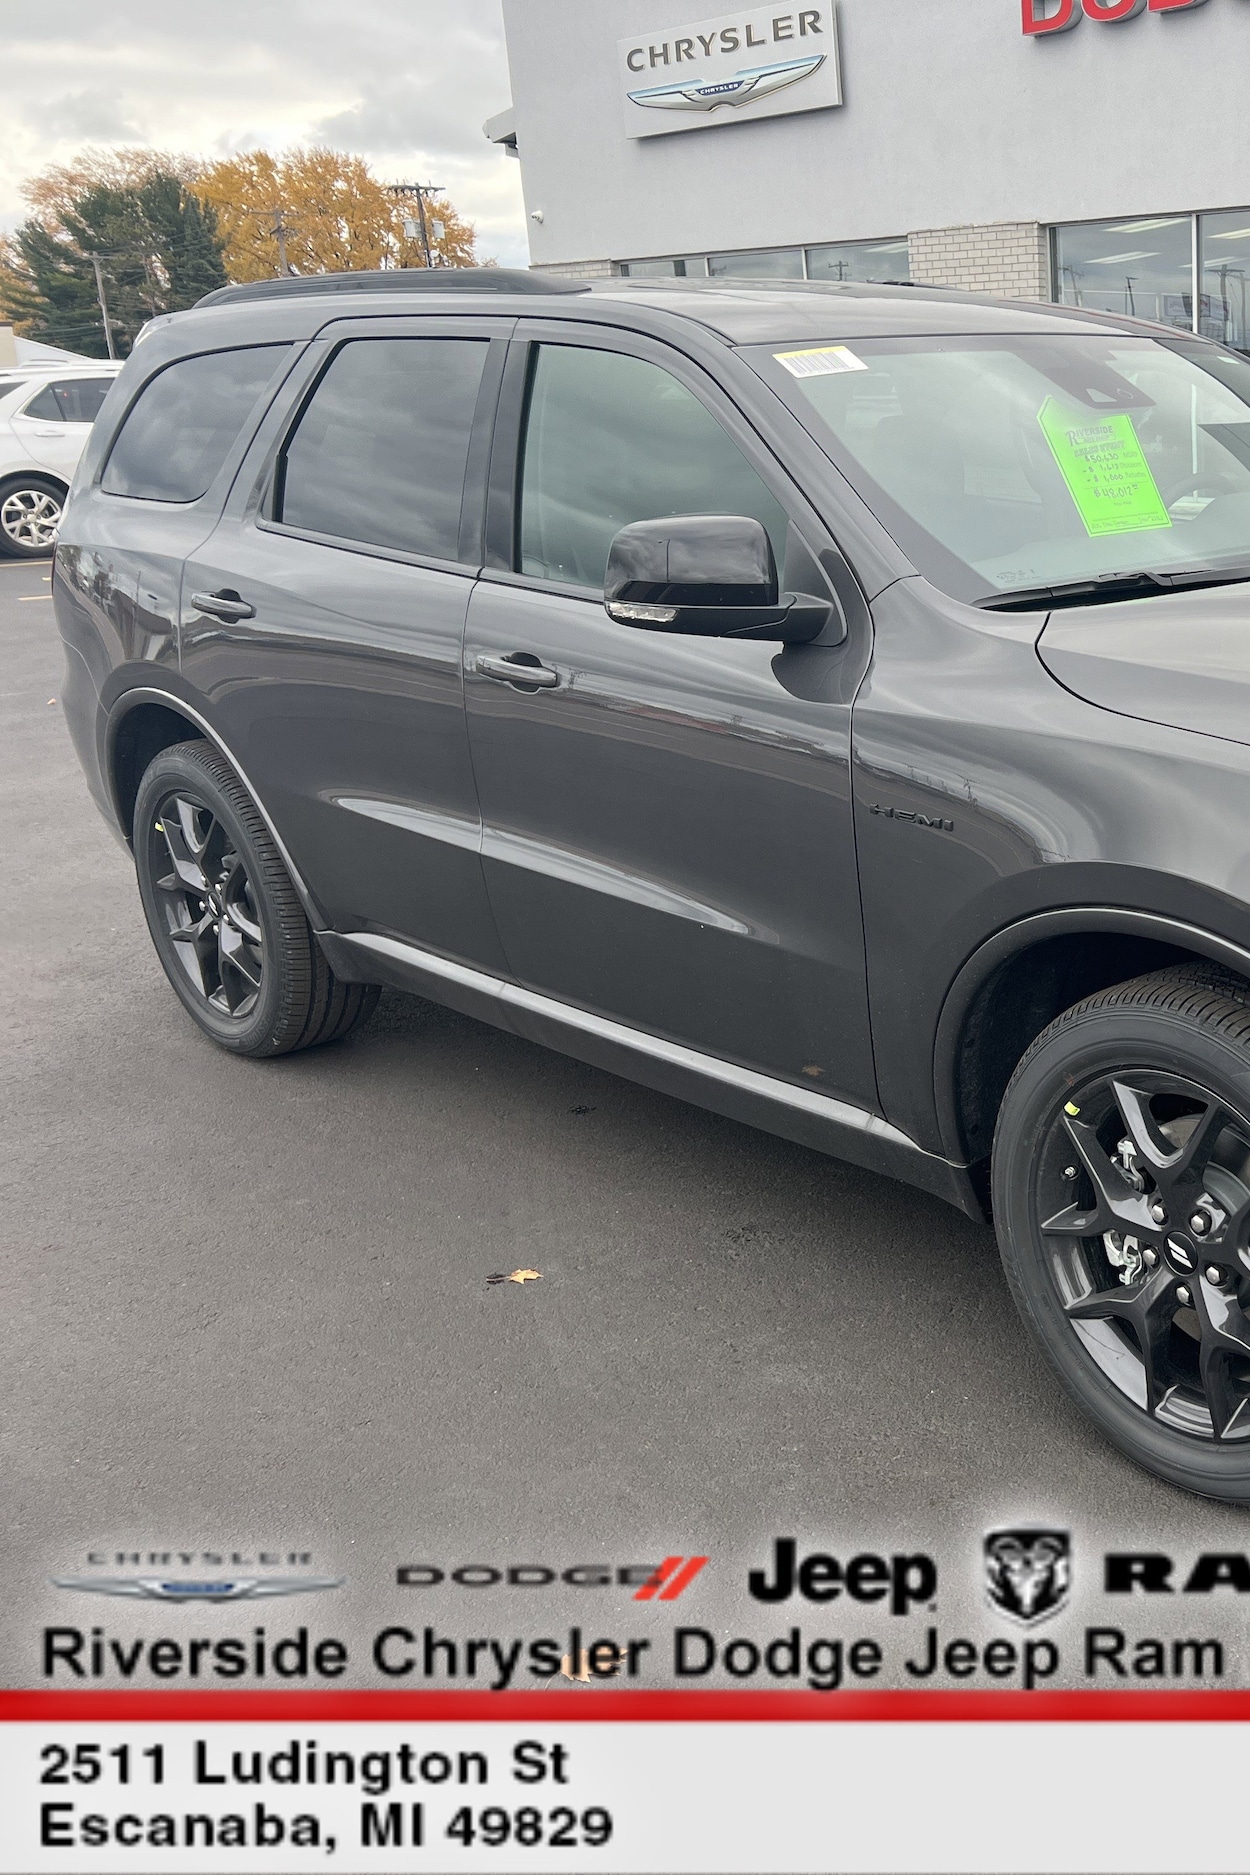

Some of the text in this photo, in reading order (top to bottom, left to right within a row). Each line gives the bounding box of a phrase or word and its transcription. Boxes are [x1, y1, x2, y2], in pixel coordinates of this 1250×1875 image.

[626, 8, 823, 73] CHRYSLER
[700, 83, 739, 95] CHRYSLER
[1066, 425, 1113, 447] RIVERSIDE
